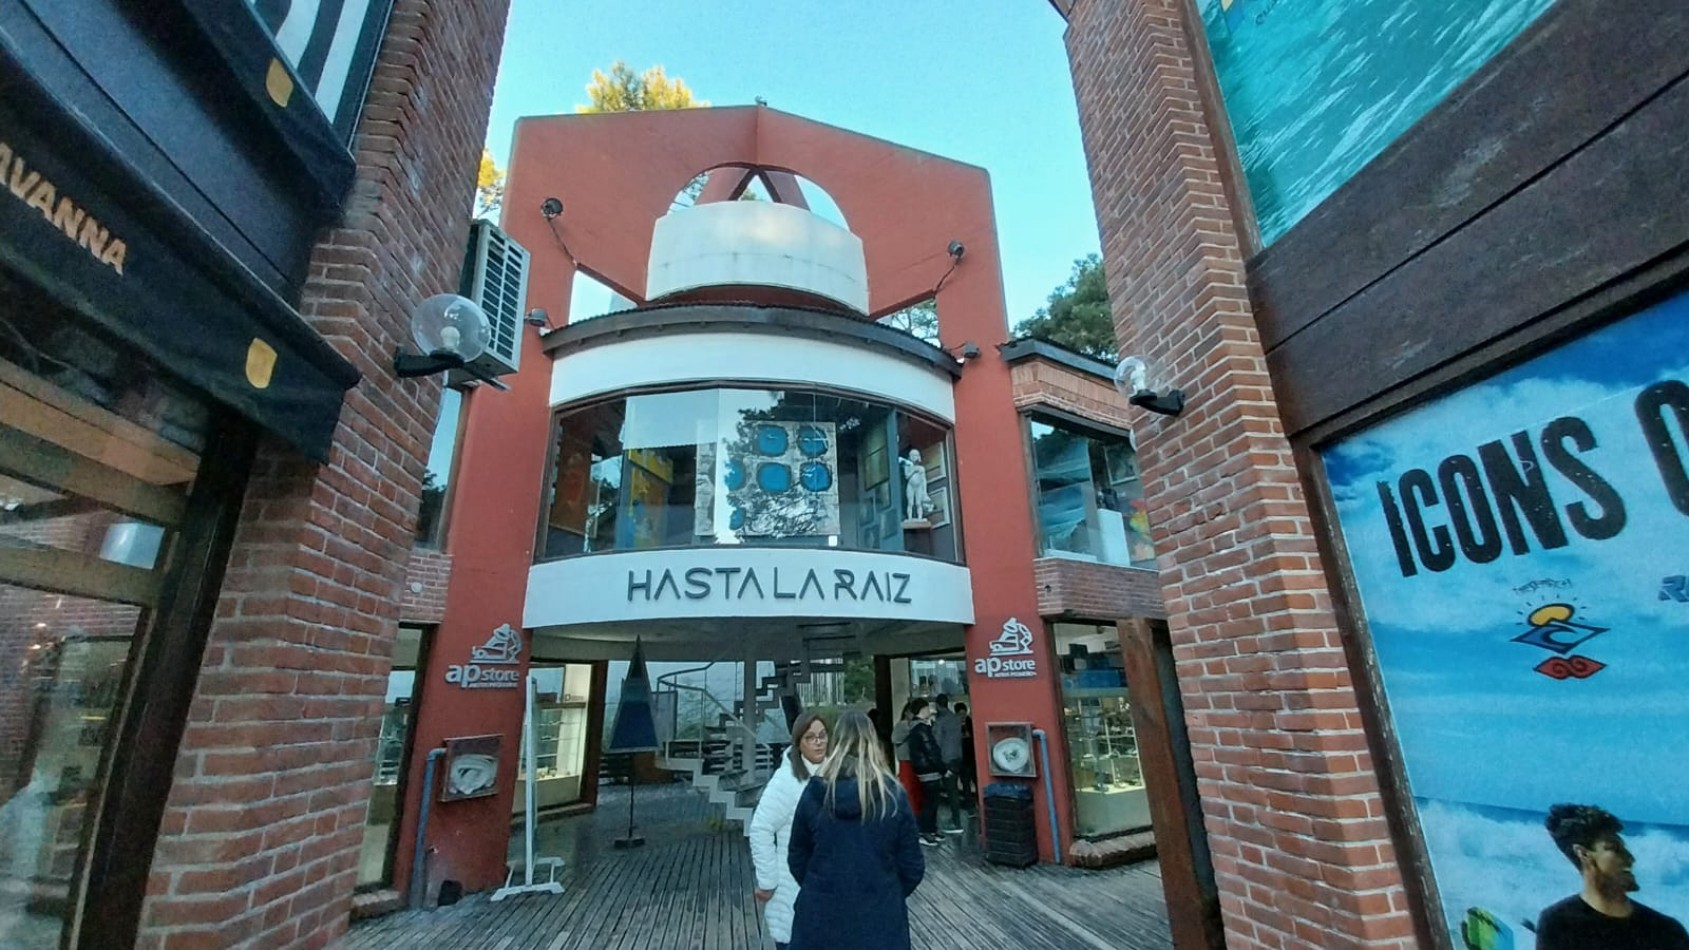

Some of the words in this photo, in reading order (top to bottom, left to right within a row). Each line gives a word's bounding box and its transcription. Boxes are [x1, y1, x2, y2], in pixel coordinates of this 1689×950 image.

[1376, 416, 1628, 578] ICONS
[627, 567, 764, 601] HASTA
[773, 567, 825, 600] LA
[833, 568, 912, 604] RAIZ
[481, 667, 520, 681] store
[1002, 659, 1036, 672] store
